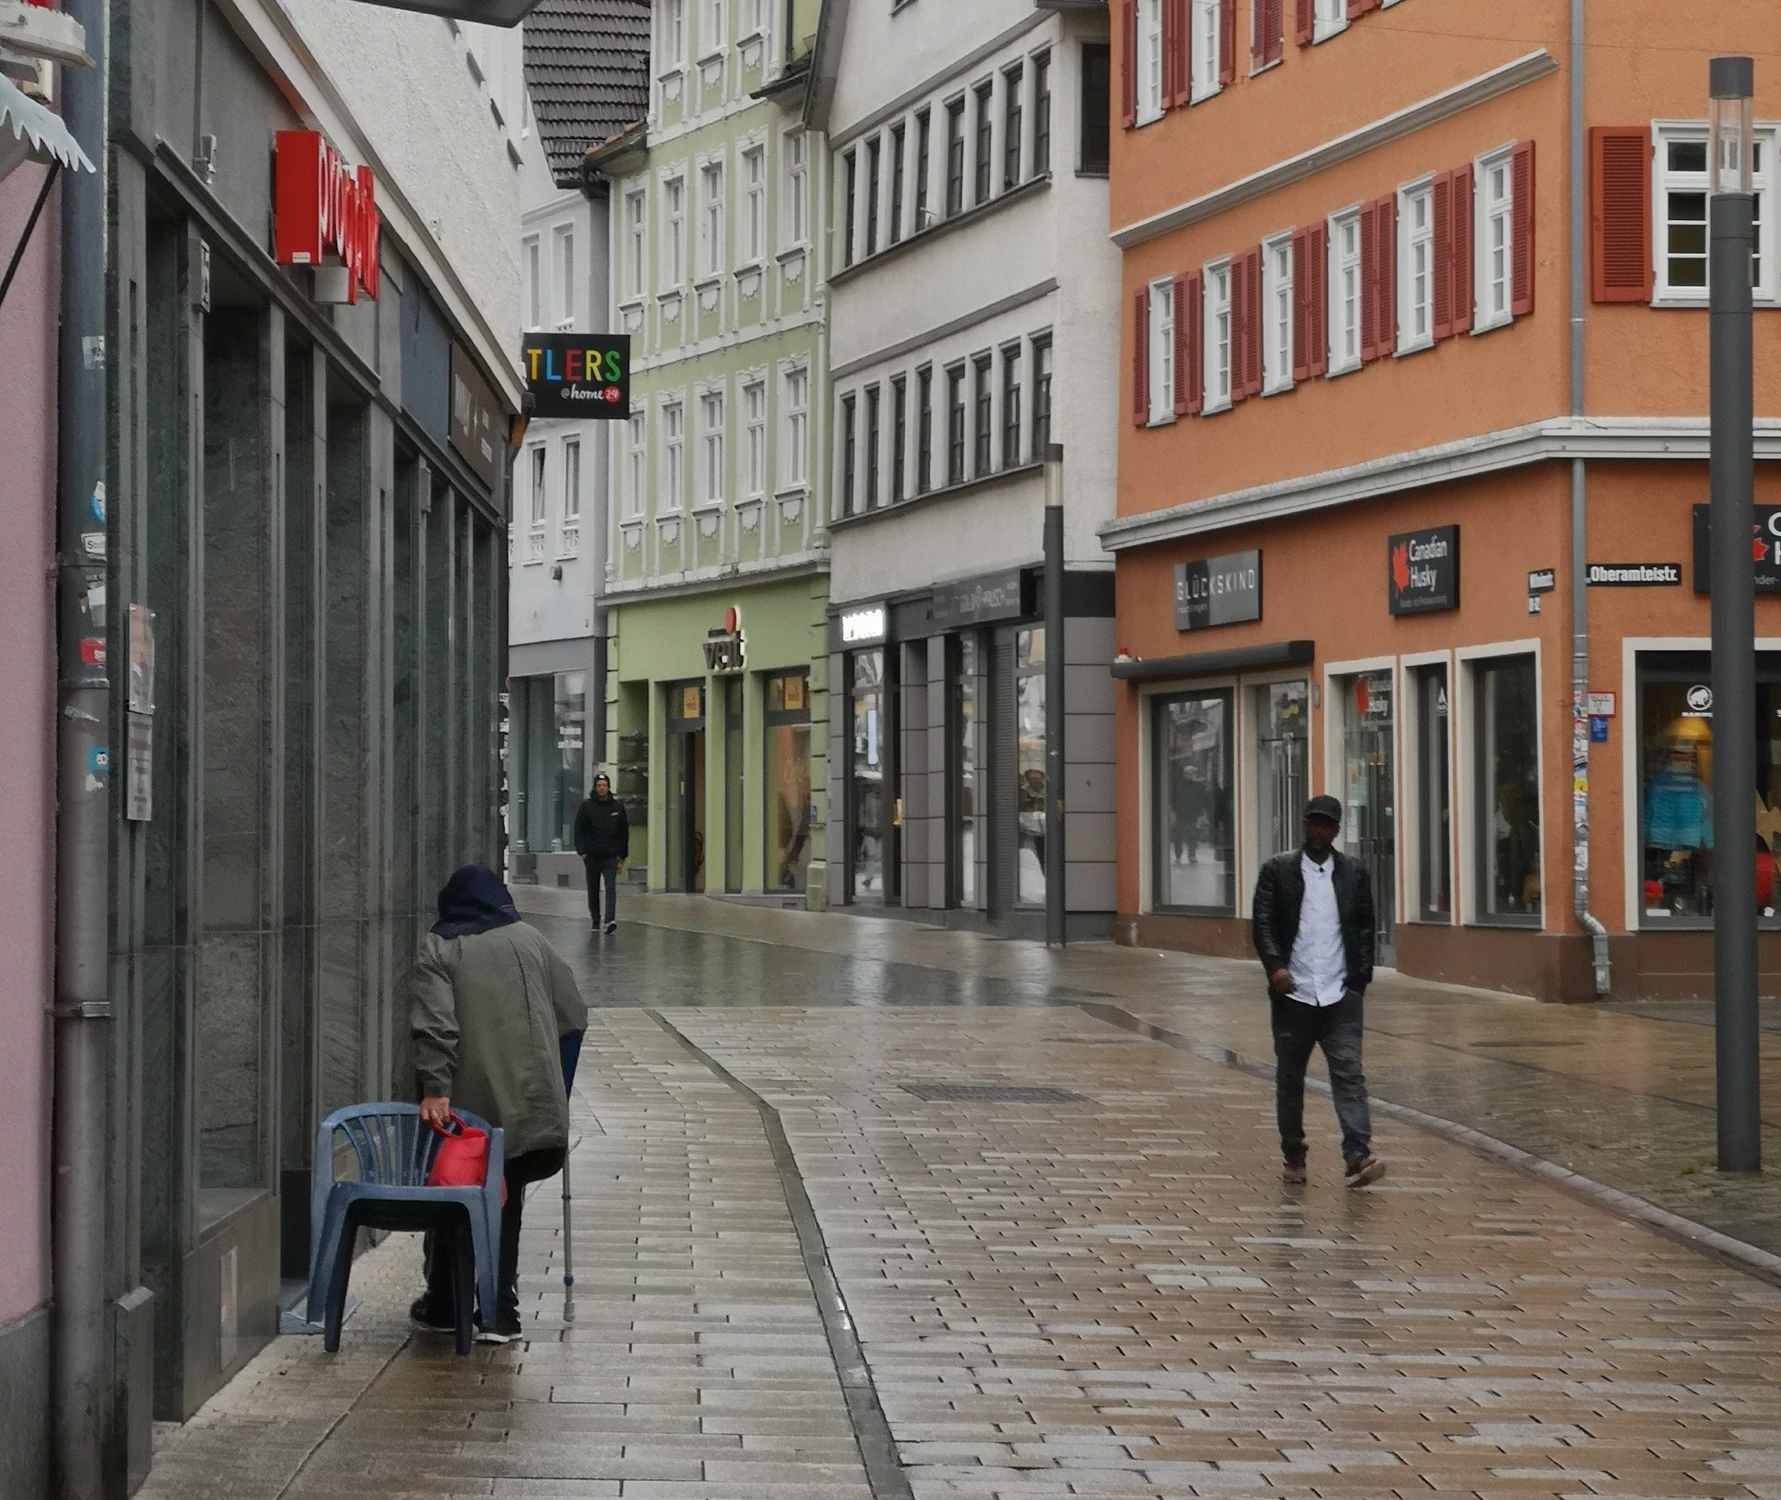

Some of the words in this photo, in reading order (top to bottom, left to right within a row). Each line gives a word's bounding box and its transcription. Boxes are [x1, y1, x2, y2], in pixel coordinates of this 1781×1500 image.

[526, 349, 621, 382] TLERS
[1409, 534, 1448, 562] Canadian
[1410, 564, 1437, 592] Husky
[1590, 565, 1679, 583] Oberamteistr.
